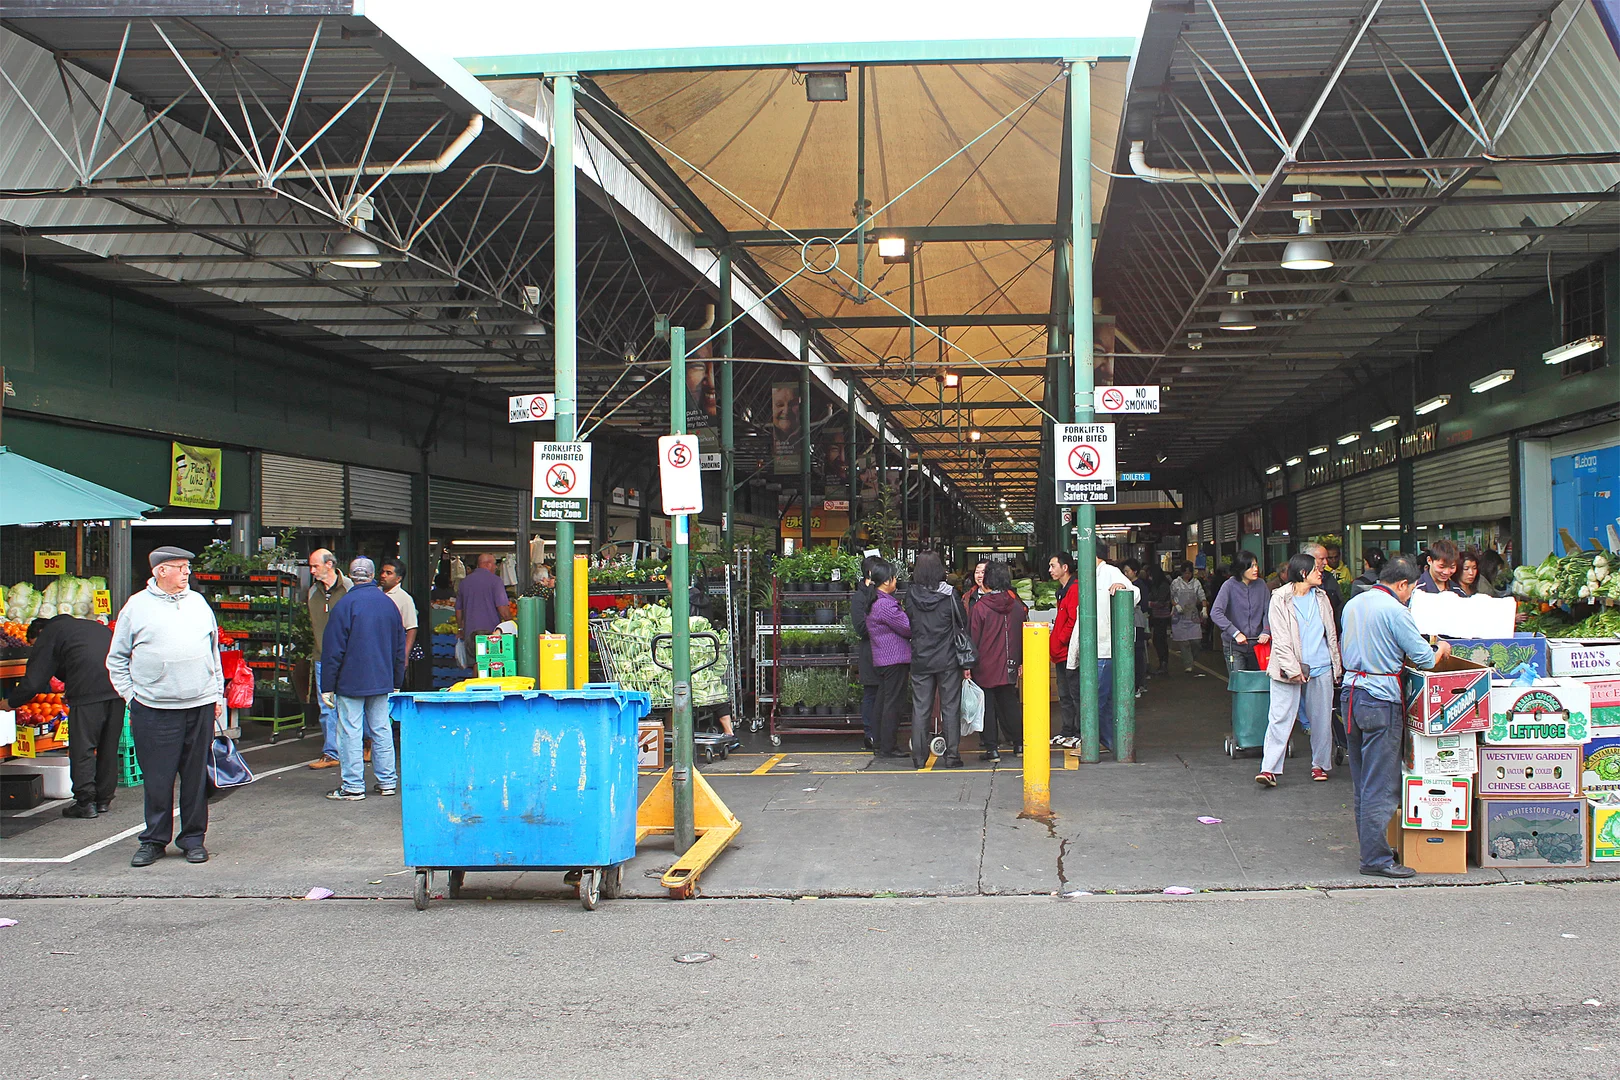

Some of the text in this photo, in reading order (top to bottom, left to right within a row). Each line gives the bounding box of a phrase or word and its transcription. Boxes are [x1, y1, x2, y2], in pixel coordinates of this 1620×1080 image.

[1136, 388, 1146, 398] NO
[516, 398, 523, 407] NO
[1124, 400, 1158, 410] SMOKING
[510, 408, 530, 420] SMOKING
[1400, 423, 1437, 459] GROCERY
[543, 444, 582, 452] FORKLIFTS
[541, 453, 584, 461] PROHIBITED
[1579, 455, 1597, 468] Lebara
[190, 462, 205, 474] Plant
[190, 474, 204, 486] Whiz
[1066, 483, 1106, 492] Pedestrian
[1064, 492, 1108, 502] Safety Zone
[542, 500, 580, 509] Pedestrian
[540, 508, 582, 519] Safety Zone
[1570, 650, 1605, 660] RYAN'S
[1571, 659, 1610, 668] MELONS
[1446, 688, 1476, 724] PEGORARO
[1535, 692, 1561, 710] CHOICE
[1510, 724, 1566, 739] LETTUCE
[1494, 806, 1575, 822] MT. WHITESTONE FARMS
